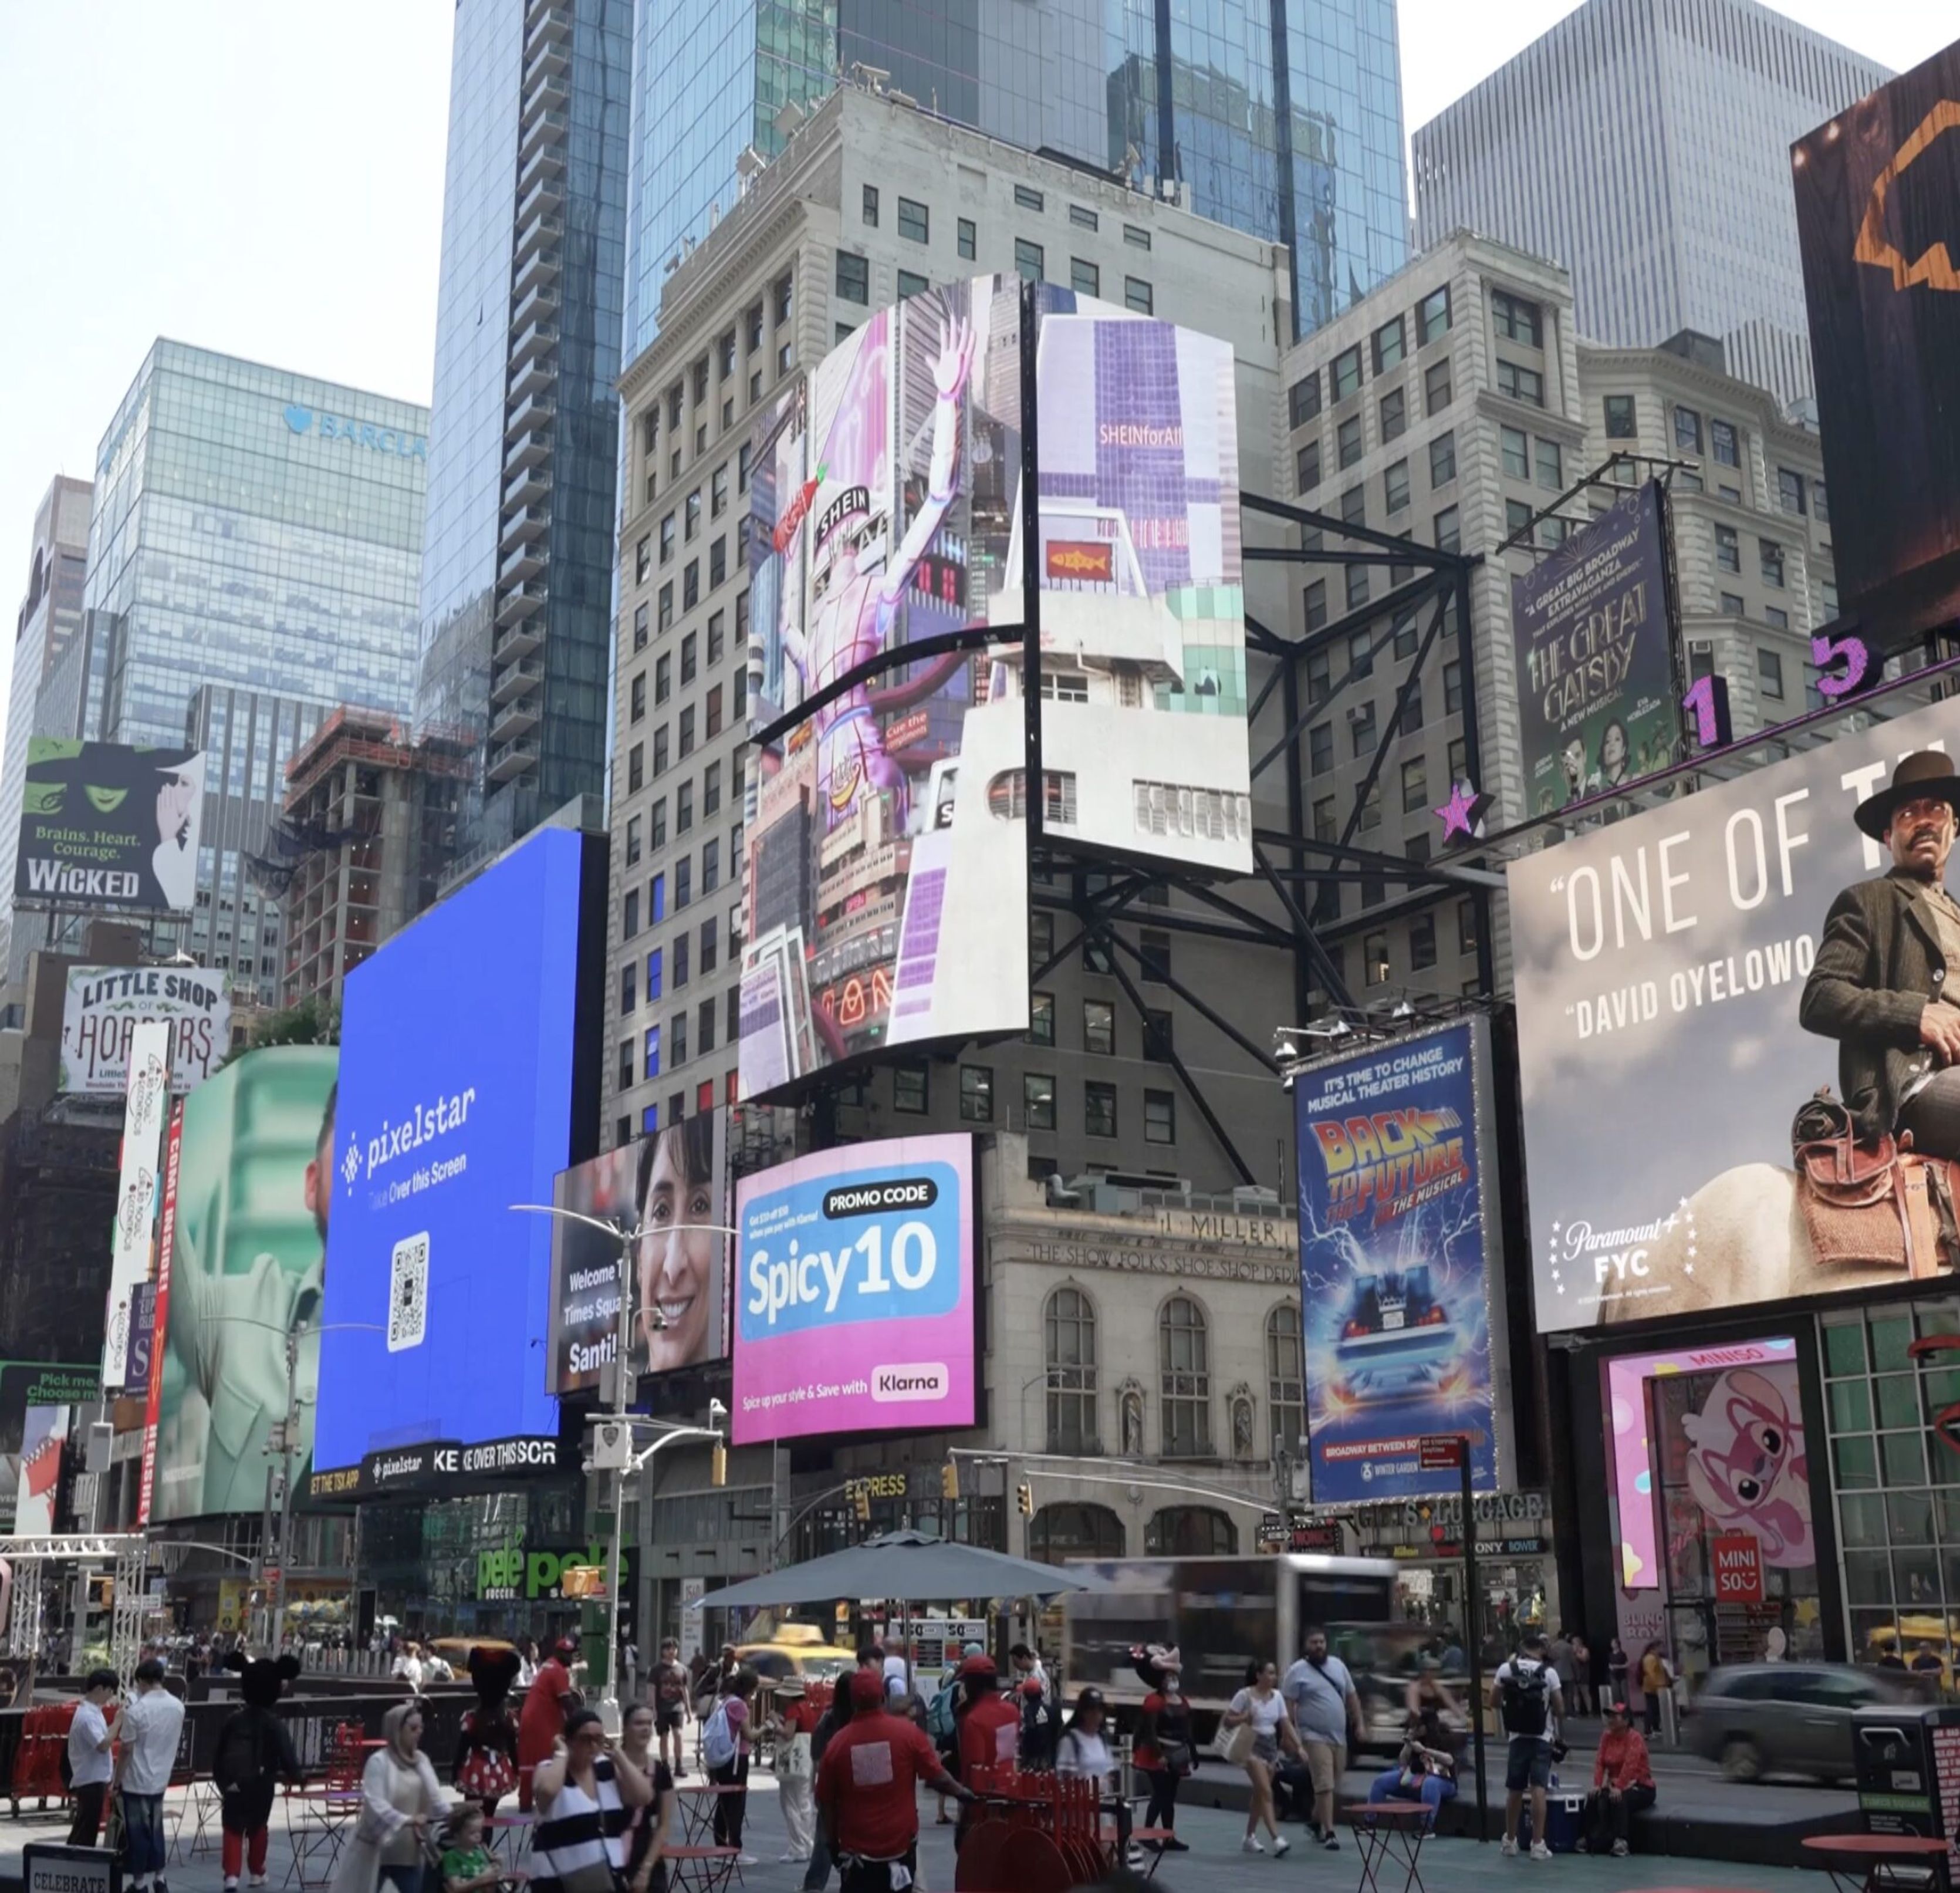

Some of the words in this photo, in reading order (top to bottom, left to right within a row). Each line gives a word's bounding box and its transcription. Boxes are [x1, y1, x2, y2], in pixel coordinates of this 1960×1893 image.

[319, 414, 427, 462] BARCLA
[1100, 424, 1182, 446] SHEINforAll
[821, 490, 866, 538] SHEIN
[1566, 568, 1584, 588] BIG
[1584, 527, 1640, 575] BROADWAY
[1548, 558, 1622, 617] EXTRAVAGANZA
[1530, 635, 1566, 694] THE
[1570, 579, 1648, 662] GREAT
[1543, 631, 1636, 724] GATSBY
[886, 723, 905, 738] Cue
[908, 711, 927, 727] the
[1560, 721, 1567, 733] A
[1567, 711, 1585, 728] NEW
[1586, 686, 1624, 717] MUSICAL
[35, 825, 90, 843] Brains.
[93, 831, 141, 846] Heart.
[53, 842, 121, 862] Courage.
[1725, 788, 1809, 910] OF
[1670, 934, 1814, 1013] OYELOWO
[82, 972, 159, 1009] LITTLE
[164, 974, 218, 1013] SHOP
[77, 1015, 212, 1079] HORRS
[1346, 1068, 1373, 1088] TIME
[1374, 1064, 1391, 1079] TO
[1393, 1046, 1444, 1073] CHANGE
[1307, 1090, 1356, 1113] MUSICAL
[1357, 1077, 1410, 1099] THEATER
[1411, 1057, 1464, 1085] HISTORY
[367, 1087, 476, 1180] pixelstar
[1310, 1106, 1449, 1175] BACK
[165, 1138, 180, 1202] COME
[389, 1179, 411, 1204] Over
[413, 1166, 430, 1193] this
[431, 1153, 467, 1185] Screen
[1327, 1173, 1358, 1204] TO
[1354, 1136, 1465, 1214] FUTURE
[830, 1189, 881, 1212] PROMO
[883, 1185, 928, 1203] CODE
[1392, 1196, 1413, 1216] THE
[1415, 1171, 1464, 1204] MUSICAL
[1191, 1215, 1278, 1242] MILLER
[748, 1221, 937, 1325] Spicy10
[1029, 1244, 1060, 1261] THE
[1067, 1246, 1111, 1266] SHOW
[1120, 1250, 1168, 1271] FOLKS
[1175, 1256, 1214, 1274] SHOE
[1219, 1262, 1259, 1280] SHOP
[1594, 1249, 1650, 1283] FYC
[569, 1266, 616, 1293] Welcome
[564, 1300, 593, 1326] Times
[596, 1293, 633, 1321] Squae
[569, 1333, 617, 1374] Santi!
[1688, 1348, 1765, 1366] MINISO
[27, 1385, 80, 1398] Choose
[40, 1373, 69, 1385] Pick
[742, 1395, 761, 1411] Spice
[761, 1394, 771, 1409] up
[772, 1391, 788, 1407] your
[788, 1386, 806, 1403] style
[807, 1385, 815, 1400] &
[816, 1382, 840, 1398] Save
[842, 1379, 868, 1395] with
[880, 1374, 939, 1392] Klarna
[433, 1450, 459, 1472] KE
[474, 1447, 495, 1470] OVER
[496, 1443, 516, 1466] THIS
[1326, 1446, 1367, 1457] BROADWAY
[1368, 1441, 1405, 1454] BETWEEN
[382, 1455, 423, 1480] pixelstar
[1375, 1463, 1395, 1475] WINTER
[1397, 1462, 1418, 1474] GARDEN
[846, 1474, 906, 1500] EXPRESS
[1475, 1542, 1503, 1554] ONY
[1719, 1550, 1755, 1568] MINI
[485, 1588, 515, 1600] SOCCER
[1624, 1612, 1665, 1625] BLIND
[33, 1872, 106, 1893] CELEBRATE
